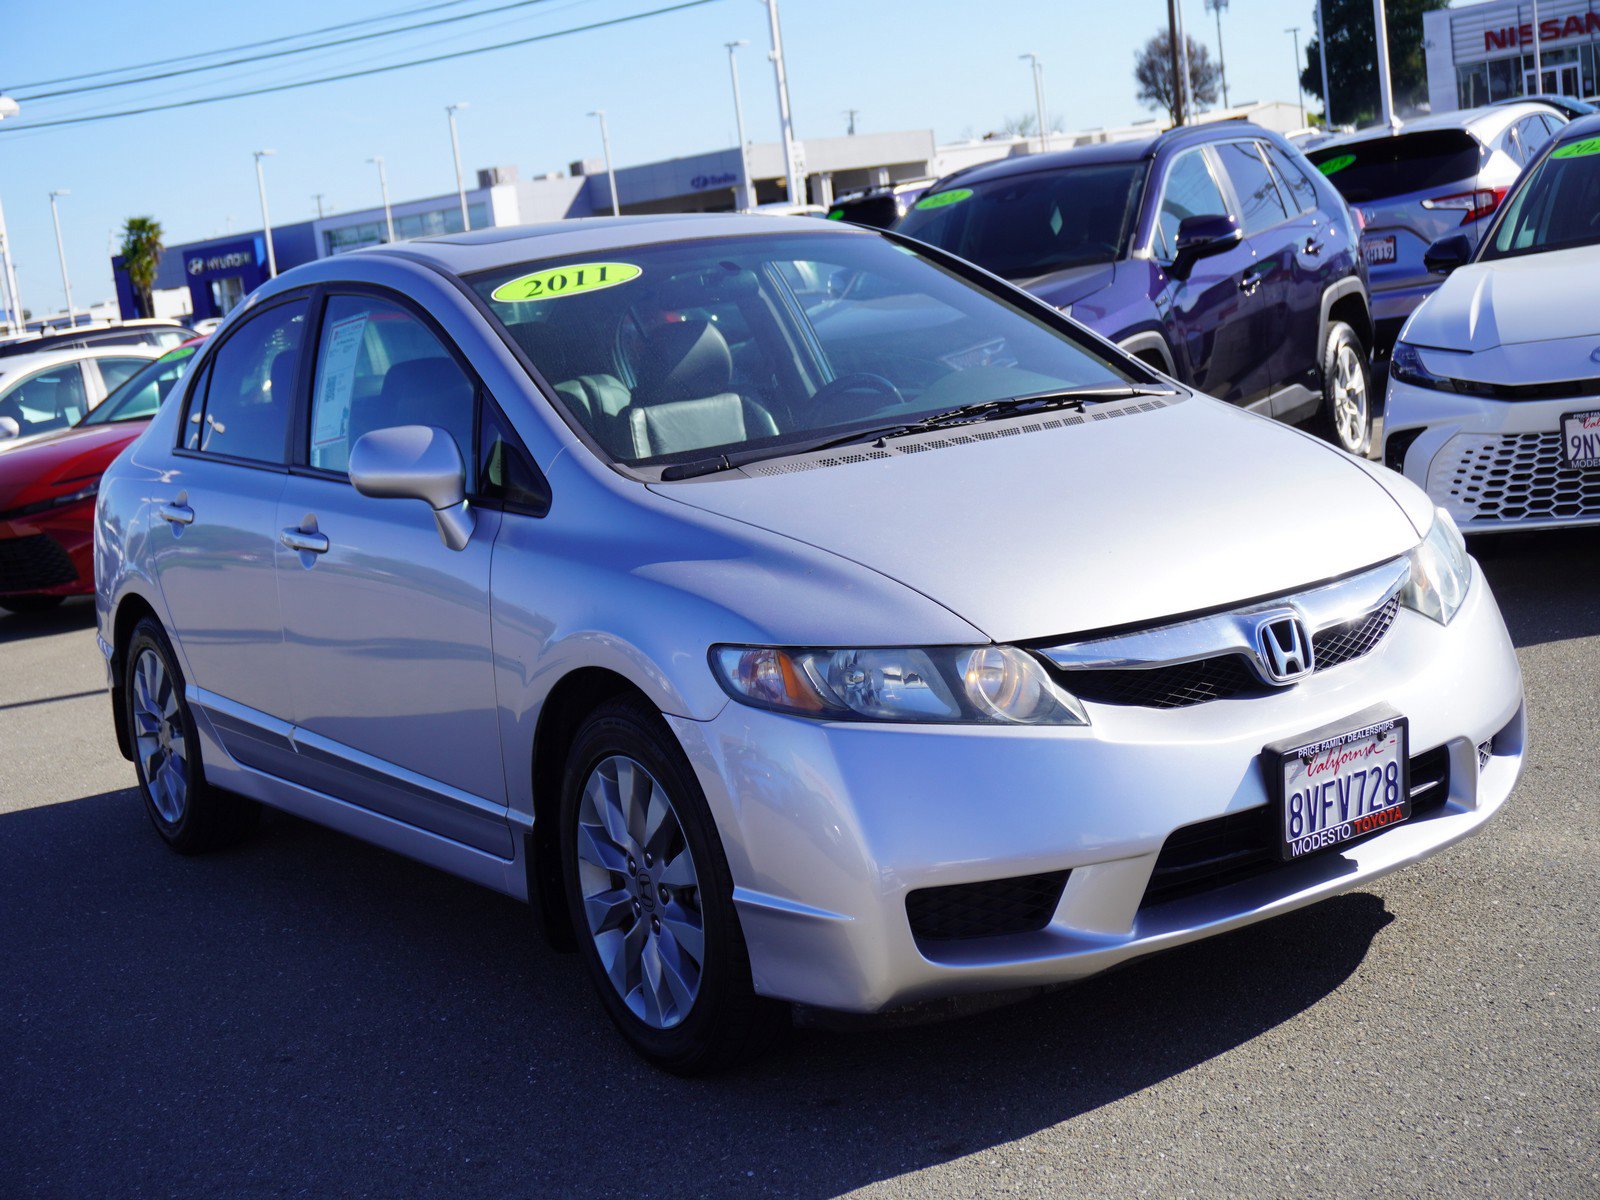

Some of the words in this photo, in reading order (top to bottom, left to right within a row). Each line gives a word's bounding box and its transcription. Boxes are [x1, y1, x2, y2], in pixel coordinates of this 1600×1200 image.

[1484, 12, 1600, 52] NISSAN
[523, 266, 608, 298] 2011
[1298, 744, 1320, 759] PRICE
[1321, 735, 1347, 751] FAMILY
[1347, 721, 1395, 743] DEALERSHIPS
[1306, 741, 1385, 778] California
[1289, 760, 1399, 839] 8VFV728
[1291, 823, 1351, 857] MODESTO
[1353, 805, 1403, 834] TOYOTA
